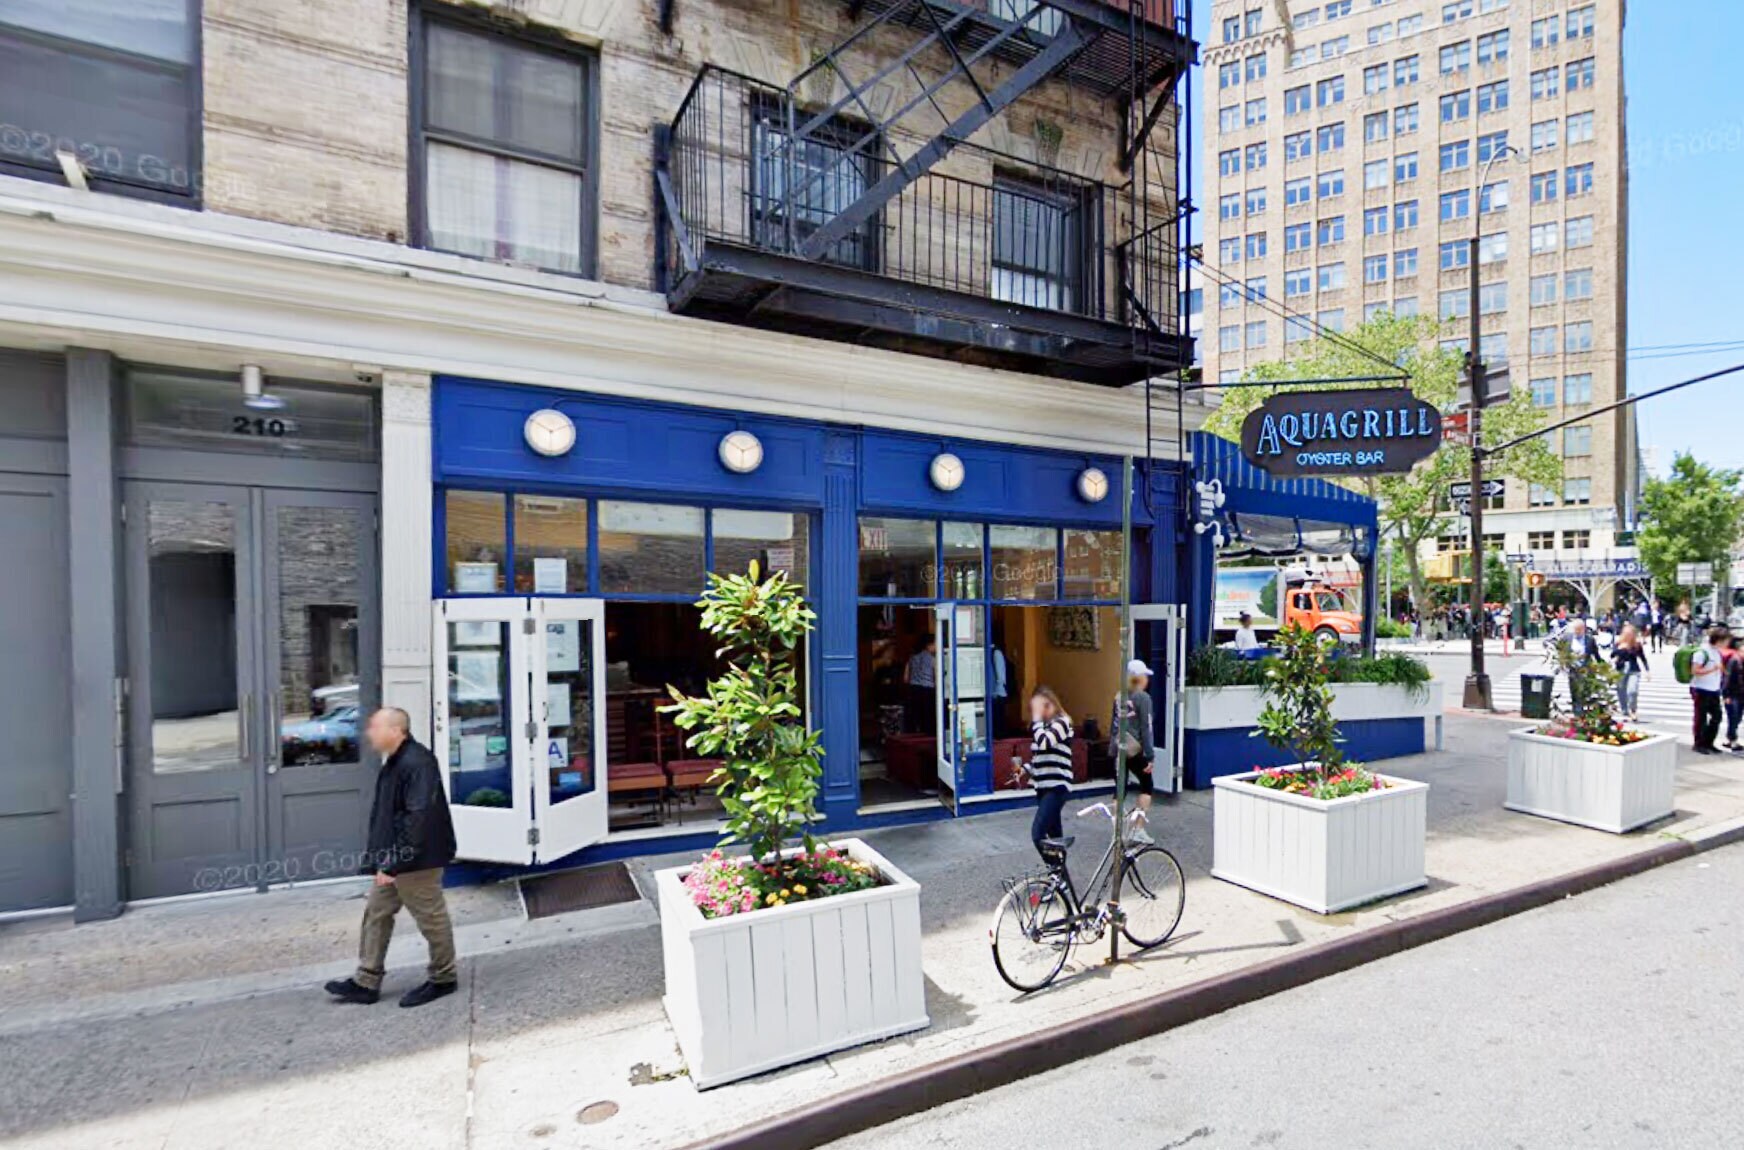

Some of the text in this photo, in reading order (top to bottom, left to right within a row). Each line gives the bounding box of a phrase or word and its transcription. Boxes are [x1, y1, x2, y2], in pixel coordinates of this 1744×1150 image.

[233, 416, 285, 437] 210
[1256, 408, 1433, 455] AQUAGRILL
[1296, 451, 1384, 466] OYSTER BAR
[549, 741, 564, 759] A
